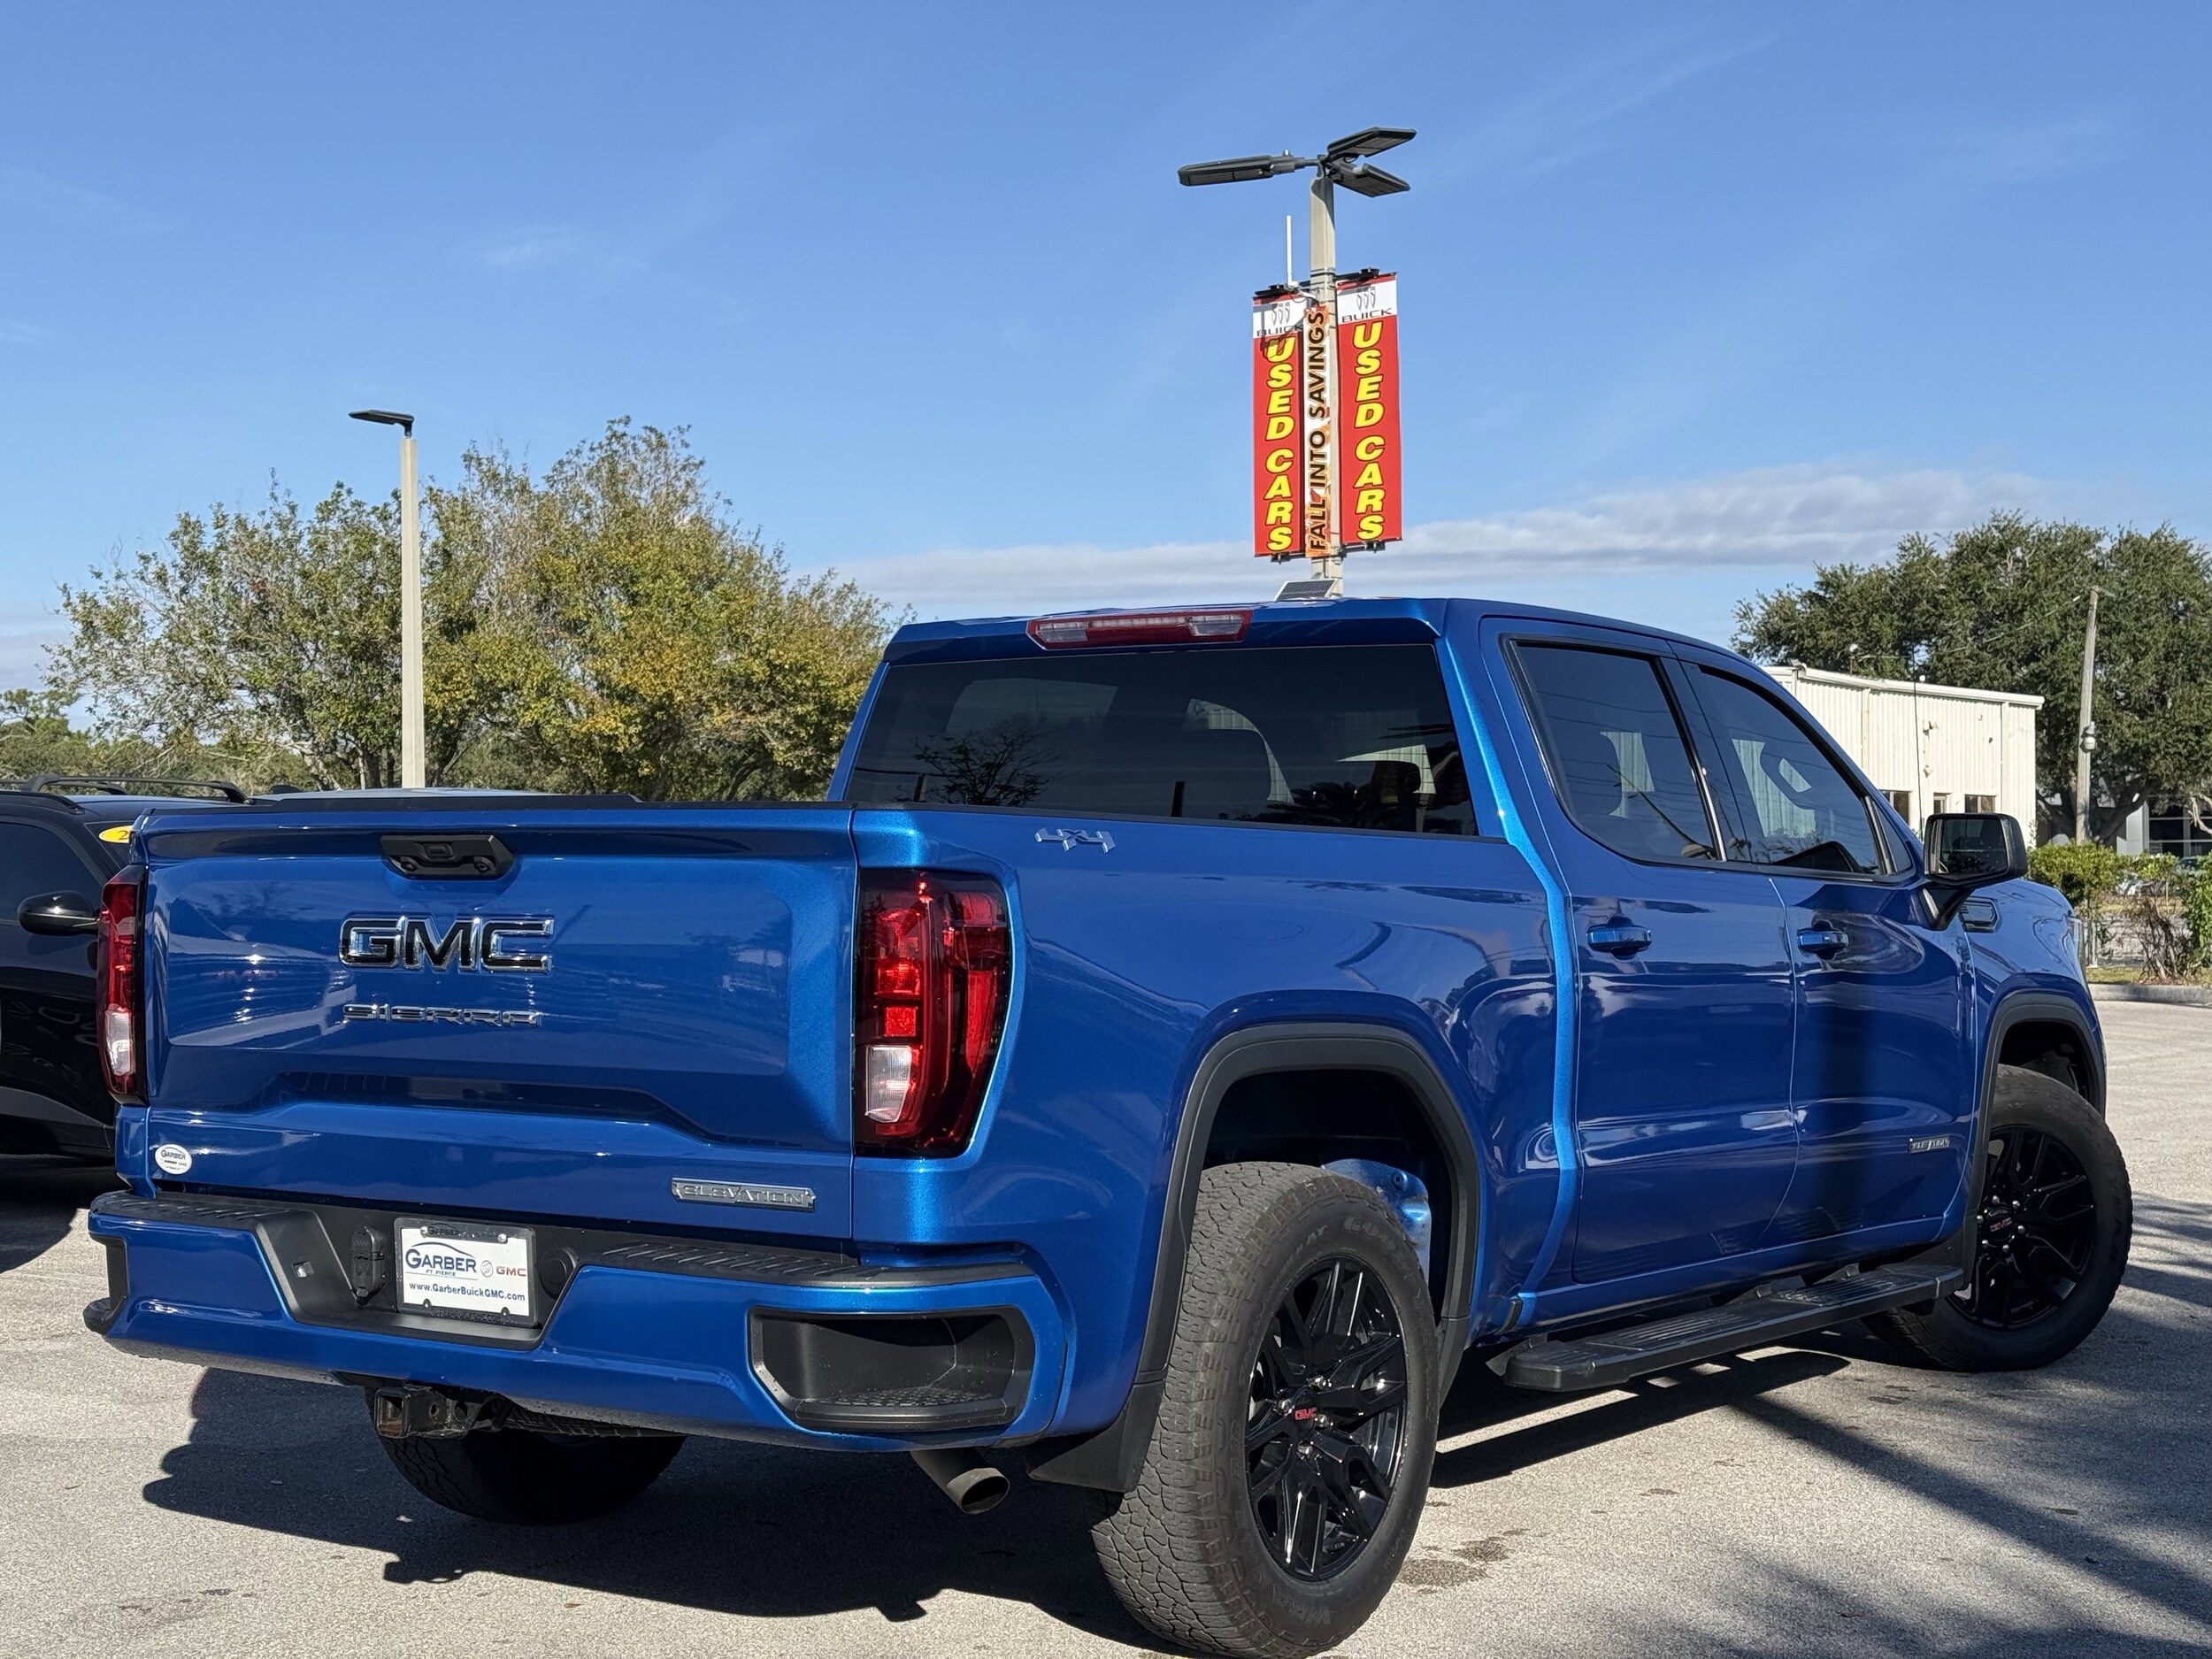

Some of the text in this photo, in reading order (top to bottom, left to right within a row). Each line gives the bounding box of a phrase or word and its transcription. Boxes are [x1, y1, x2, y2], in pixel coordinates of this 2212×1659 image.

[1341, 309, 1393, 324] BUICK
[1264, 335, 1295, 551] USED CARS
[1308, 311, 1327, 550] FALL INTO SAVINGS
[1353, 321, 1386, 541] USED CARS
[339, 914, 555, 974] GMC
[342, 1003, 542, 1026] SIERRA
[682, 1186, 804, 1204] ELEVATION
[405, 1248, 526, 1277] GARBER GMC
[409, 1282, 526, 1302] www.GarberBuickGMC.com
[1294, 1407, 1317, 1420] GMC
